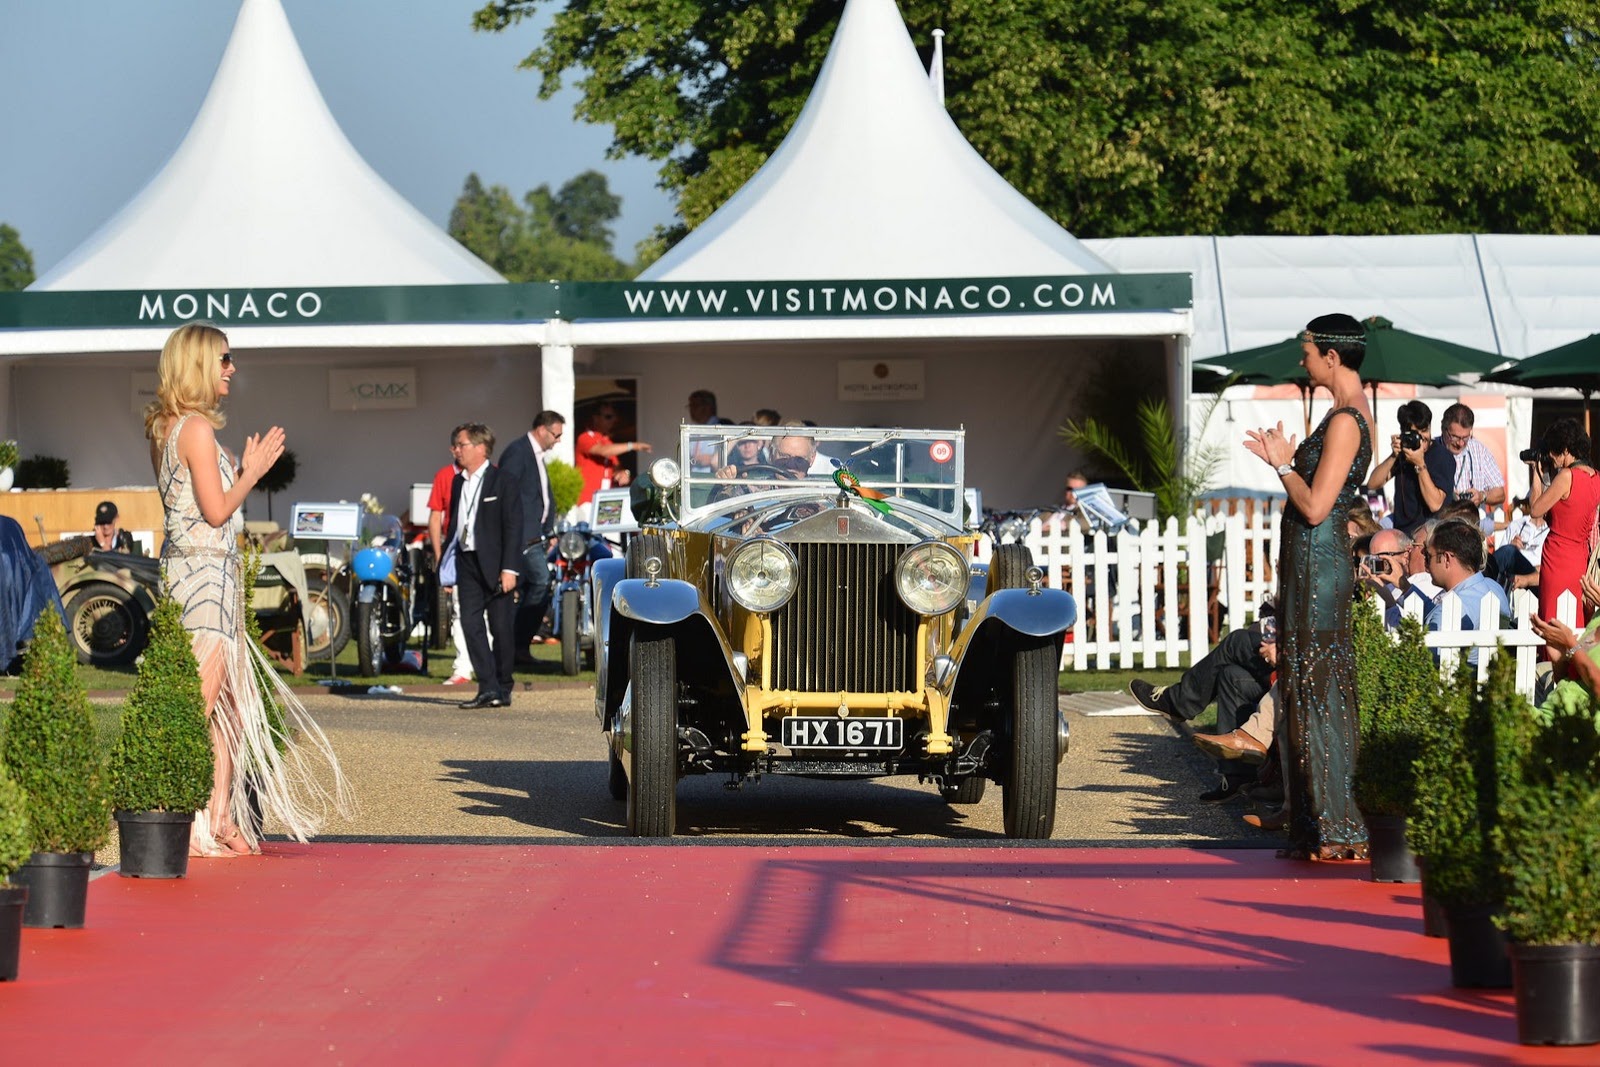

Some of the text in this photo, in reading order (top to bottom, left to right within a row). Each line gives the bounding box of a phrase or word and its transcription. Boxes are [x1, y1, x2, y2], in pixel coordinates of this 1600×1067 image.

[138, 292, 322, 320] MONACO
[623, 282, 1116, 313] WWW.VISITMONACO.COM
[358, 382, 409, 399] CMX
[791, 720, 894, 746] HX 1671
